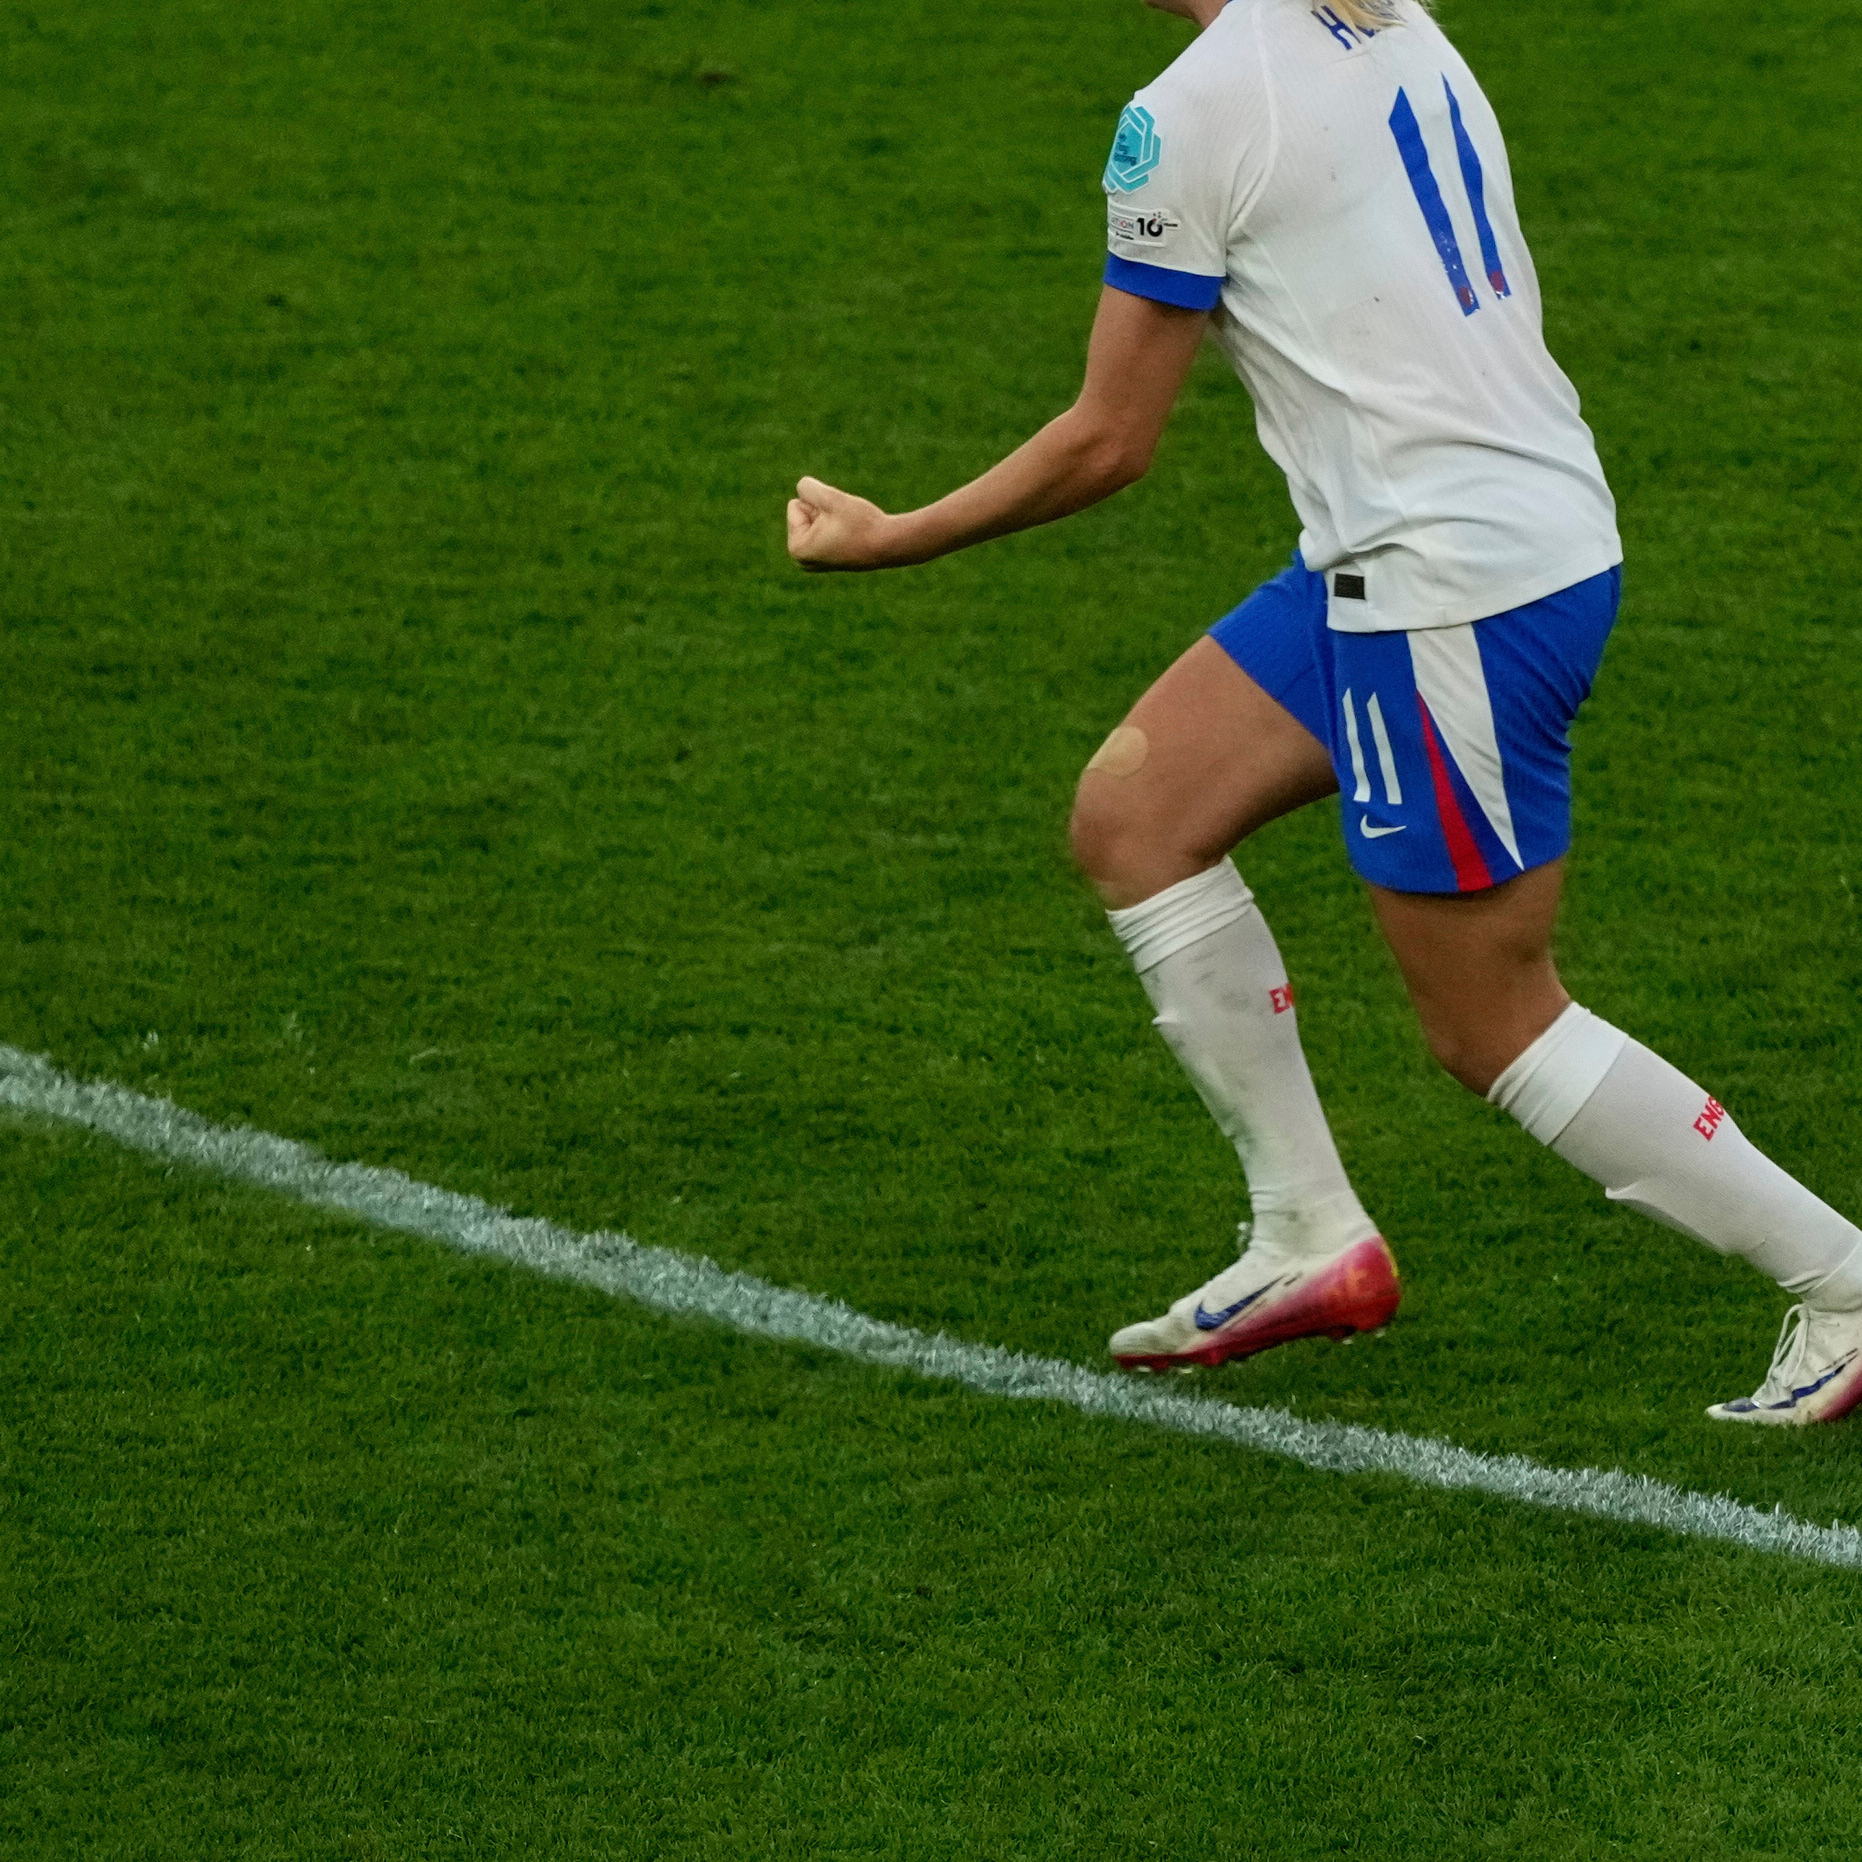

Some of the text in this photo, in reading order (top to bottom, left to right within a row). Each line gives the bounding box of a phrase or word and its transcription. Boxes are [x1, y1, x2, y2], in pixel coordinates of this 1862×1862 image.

[1136, 216, 1164, 237] 10
[1388, 71, 1511, 317] 11
[1342, 688, 1402, 805] 11
